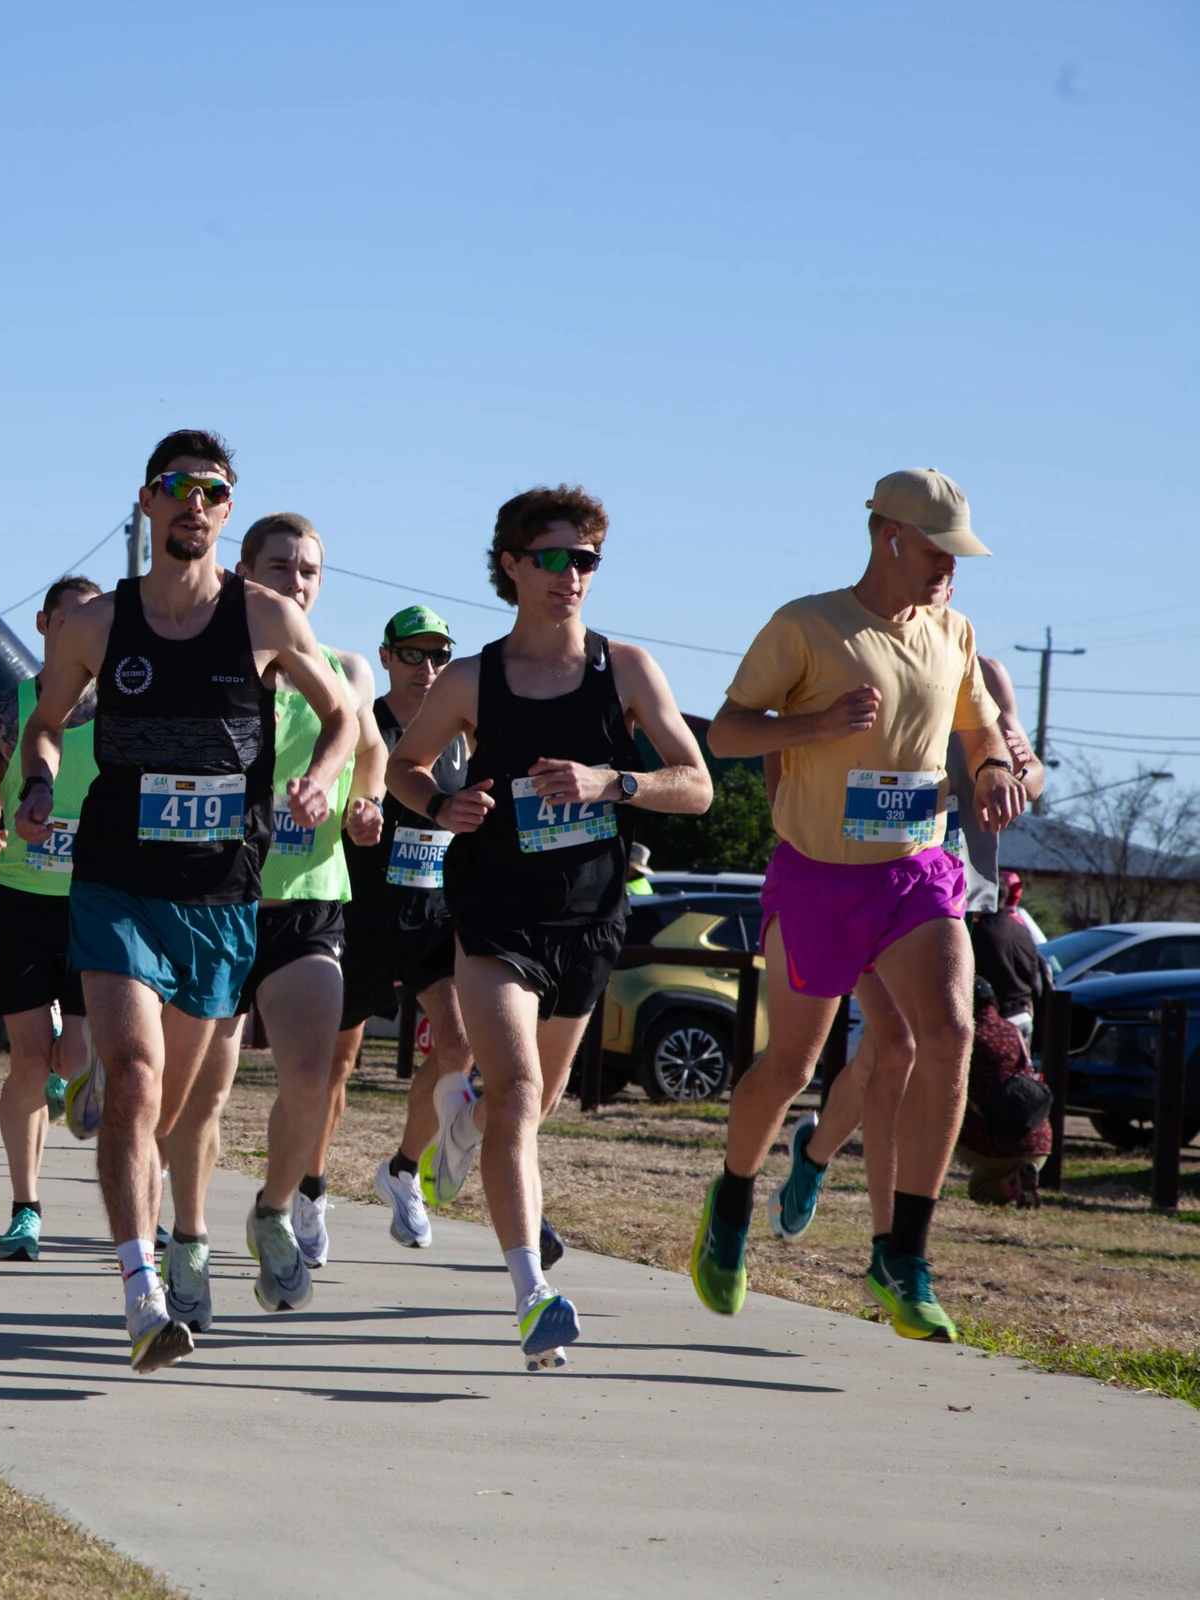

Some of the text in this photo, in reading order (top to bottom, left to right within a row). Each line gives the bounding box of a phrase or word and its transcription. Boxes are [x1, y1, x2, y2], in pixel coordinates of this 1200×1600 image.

[212, 675, 245, 683] SCODY
[877, 790, 916, 809] ORY
[160, 796, 222, 828] 419
[886, 810, 905, 820] 320
[43, 832, 73, 856] 42
[397, 843, 448, 862] ANDRE
[420, 861, 435, 871] 358
